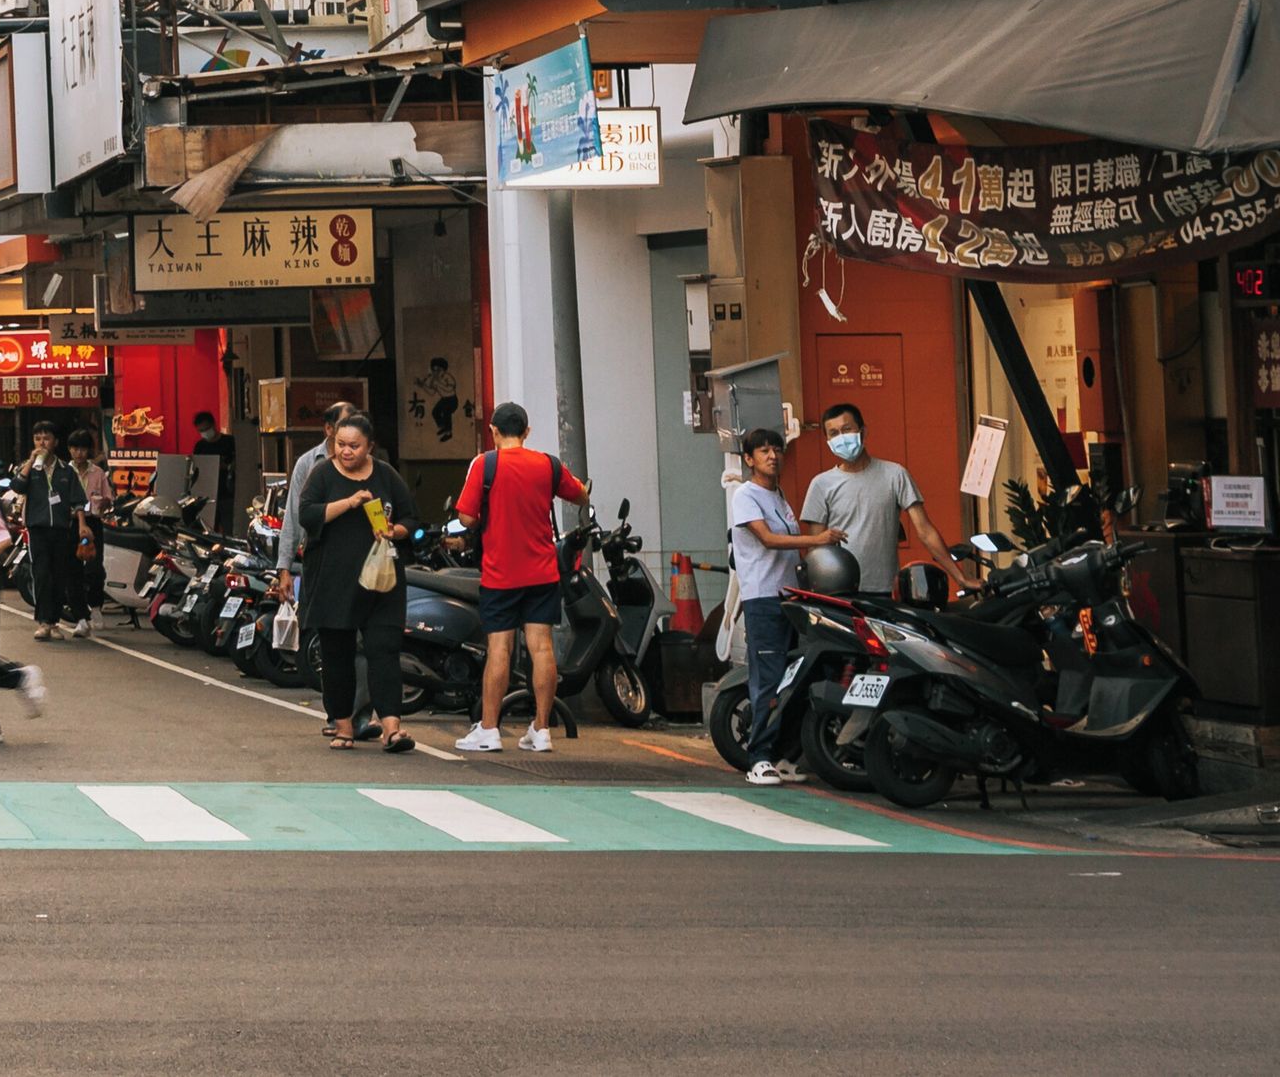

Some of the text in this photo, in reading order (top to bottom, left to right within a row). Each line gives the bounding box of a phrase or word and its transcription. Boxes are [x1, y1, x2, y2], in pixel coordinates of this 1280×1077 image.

[628, 152, 657, 162] GUEI
[628, 162, 657, 171] BING
[147, 215, 319, 260] 大王麻辣
[148, 259, 320, 273] TAIWAN KING
[2, 392, 20, 404] 150
